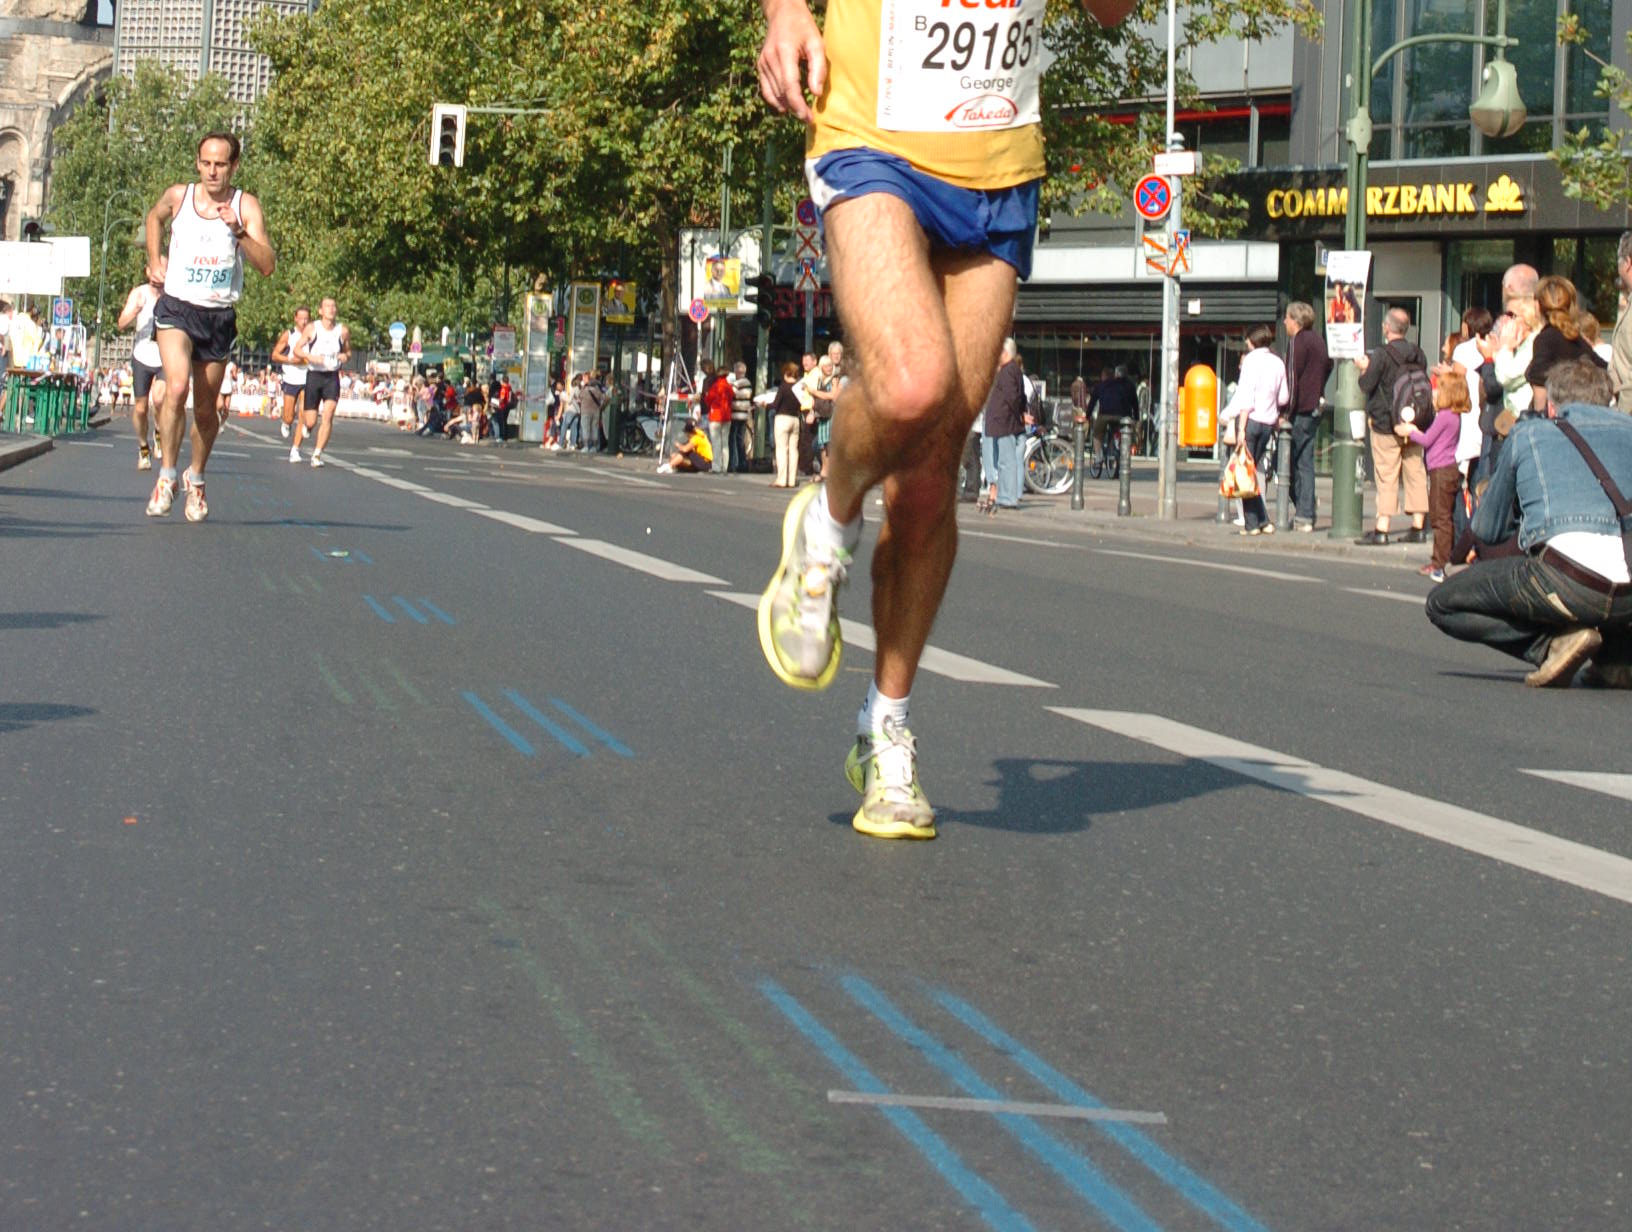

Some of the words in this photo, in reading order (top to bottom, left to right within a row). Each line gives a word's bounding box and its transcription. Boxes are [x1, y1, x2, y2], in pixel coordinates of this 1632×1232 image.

[921, 18, 1034, 71] 29185
[960, 76, 1014, 92] George
[962, 108, 1012, 122] Takeda
[1266, 183, 1476, 218] COMMRZBANK
[187, 268, 228, 285] 35785
